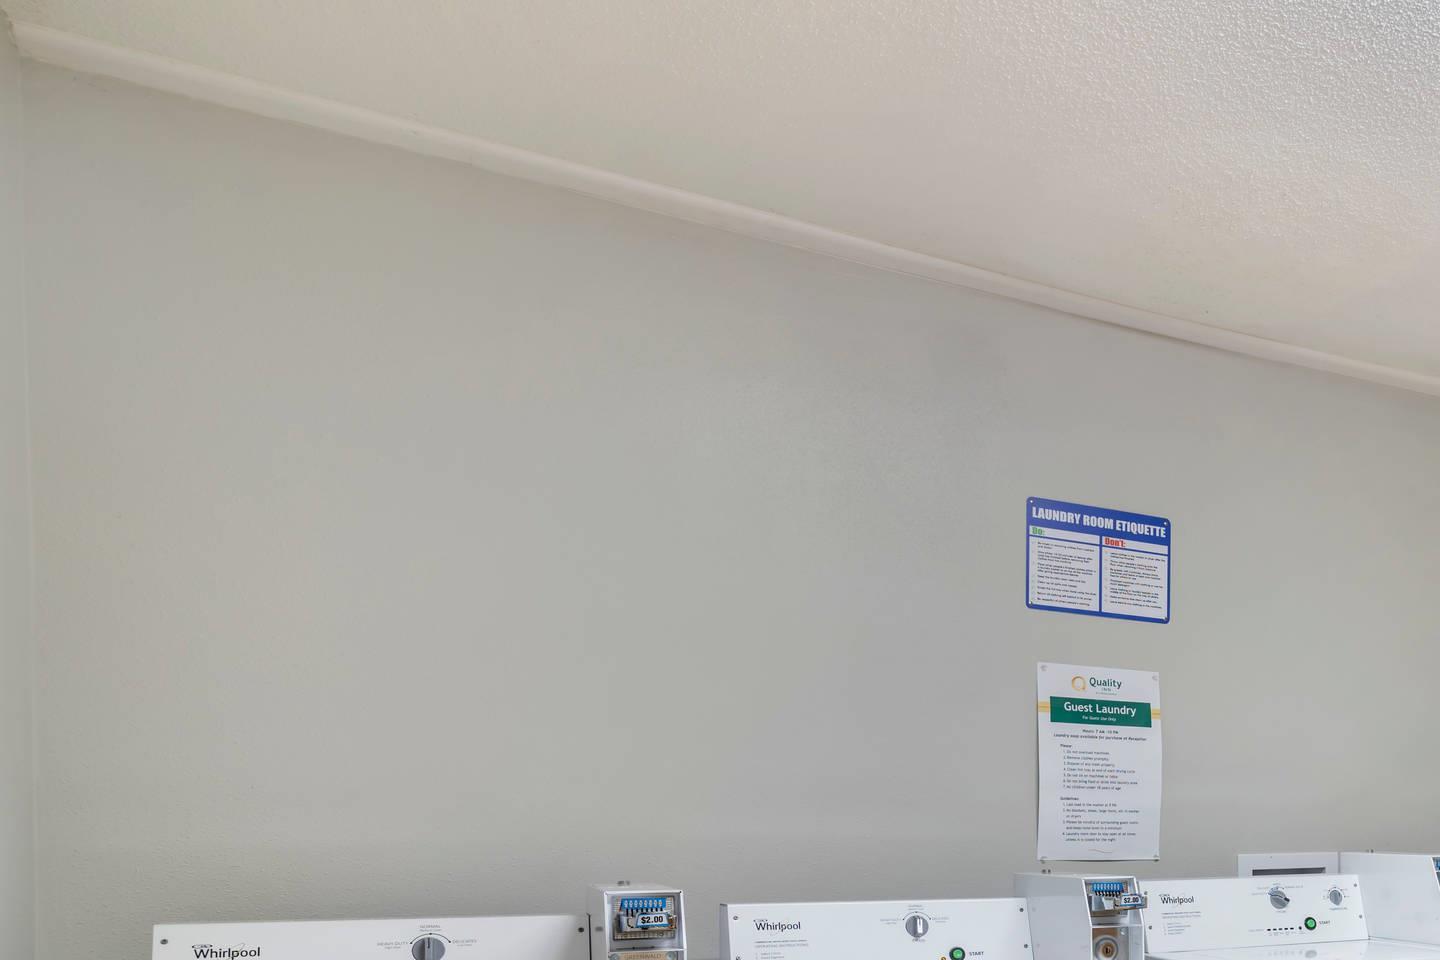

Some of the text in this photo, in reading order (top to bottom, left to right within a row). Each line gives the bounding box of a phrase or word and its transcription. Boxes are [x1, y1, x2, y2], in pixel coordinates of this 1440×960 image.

[1032, 506, 1167, 538] LAUNDRY ROOM ETIQUETTE
[1089, 677, 1122, 690] Quality
[1063, 701, 1137, 718] Guest Laundry
[1160, 895, 1195, 905] Whirlpool
[640, 915, 664, 925] $2.00
[755, 921, 801, 933] Whirlpool
[193, 946, 261, 960] Whirlpool
